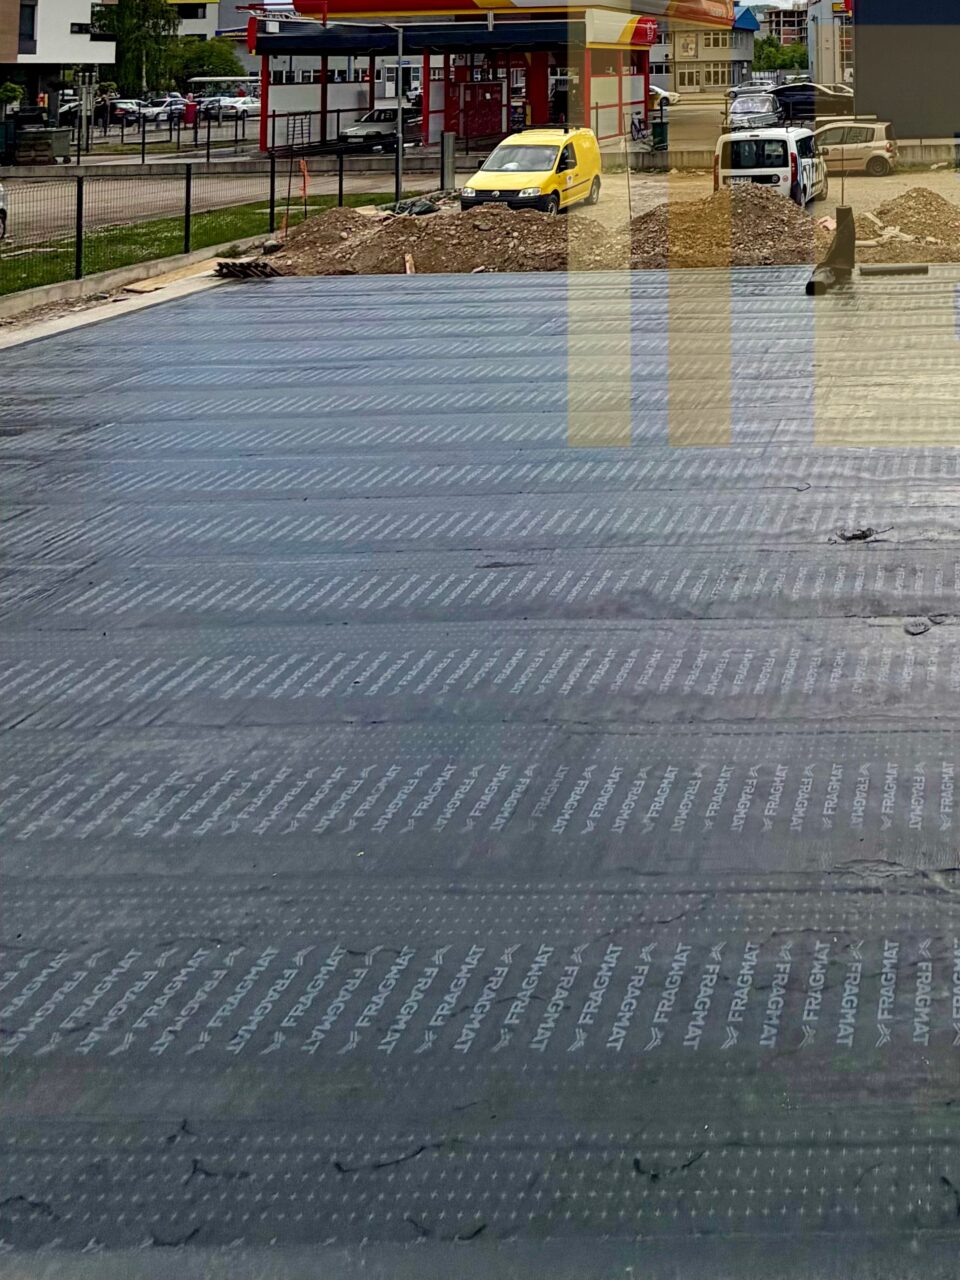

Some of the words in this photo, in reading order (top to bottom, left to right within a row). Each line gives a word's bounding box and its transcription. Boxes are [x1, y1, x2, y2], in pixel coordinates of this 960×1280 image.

[0, 949, 70, 1018] RAGMAT
[0, 971, 88, 1056] FRAGMAT
[60, 948, 142, 1028] FRAGMAT
[75, 970, 158, 1055] FRAGMAT
[133, 948, 211, 1028] FRAGMAT
[150, 970, 227, 1055] FRAGMAT
[207, 946, 278, 1028] FRAGMAT
[226, 969, 299, 1054] FRAGMAT
[281, 945, 347, 1027] FRAGMAT
[303, 969, 368, 1054] FRAGMAT
[356, 945, 416, 1027] FRAGMAT
[378, 967, 438, 1054] FRAGMAT
[429, 945, 485, 1026] FRAGMAT
[453, 967, 508, 1053] FRAGMAT
[504, 944, 554, 1024] FRAGMAT
[529, 966, 579, 1052] FRAGMAT
[578, 943, 623, 1024] FRAGMAT
[606, 966, 649, 1051] FRAGMAT
[653, 942, 693, 1022] FRAGMAT
[683, 965, 720, 1049] FRAGMAT
[728, 942, 760, 1021] FRAGMAT
[759, 964, 791, 1048] FRAGMAT
[803, 941, 830, 1020] FRAGMAT
[836, 962, 862, 1047] FRAGMAT
[877, 940, 899, 1019] FRAGMAT
[913, 962, 932, 1046] FRAGMAT
